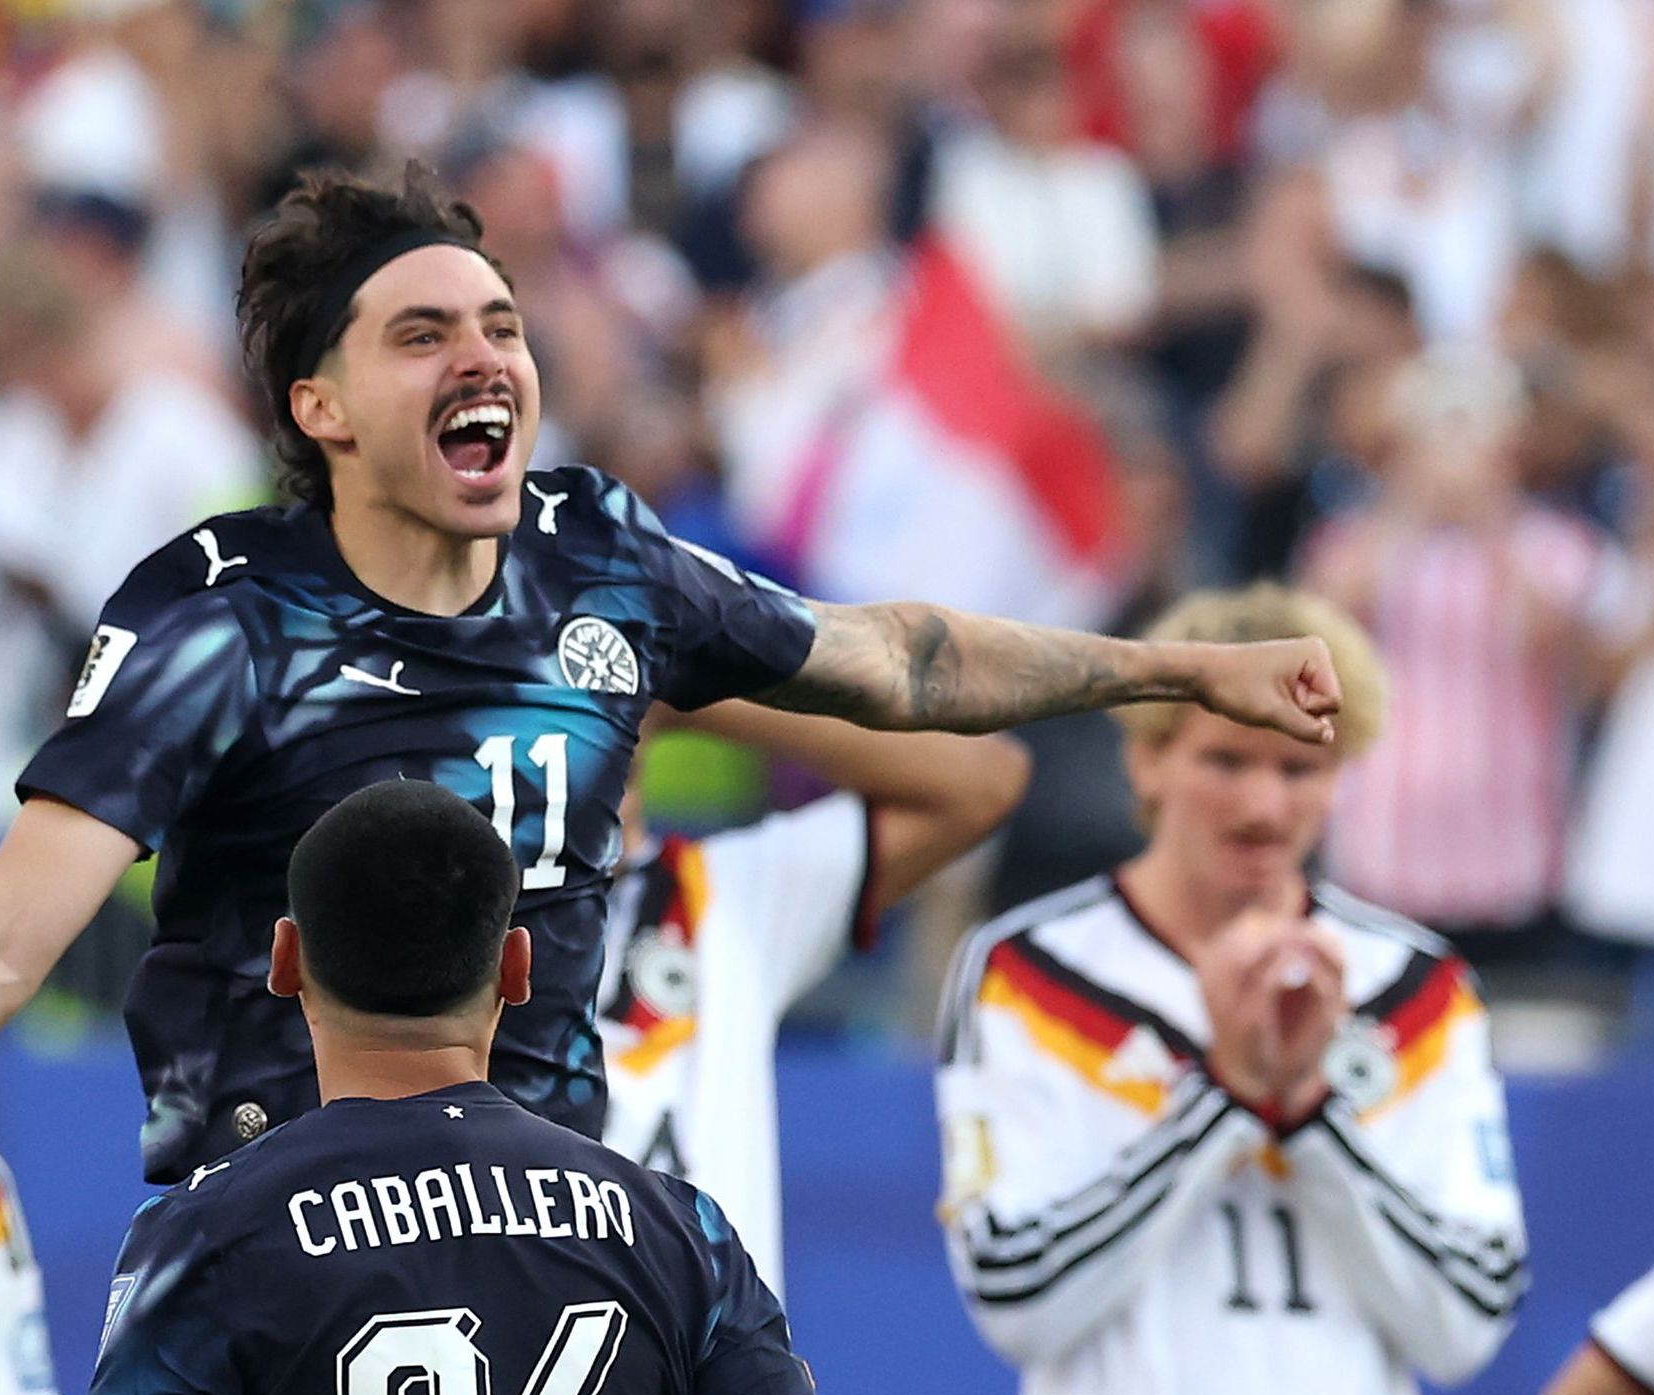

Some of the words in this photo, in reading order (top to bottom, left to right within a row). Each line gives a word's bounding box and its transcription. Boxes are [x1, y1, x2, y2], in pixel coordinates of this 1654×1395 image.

[473, 733, 569, 891] 11
[288, 1163, 635, 1257] CABALLERO
[1217, 1199, 1318, 1315] 11
